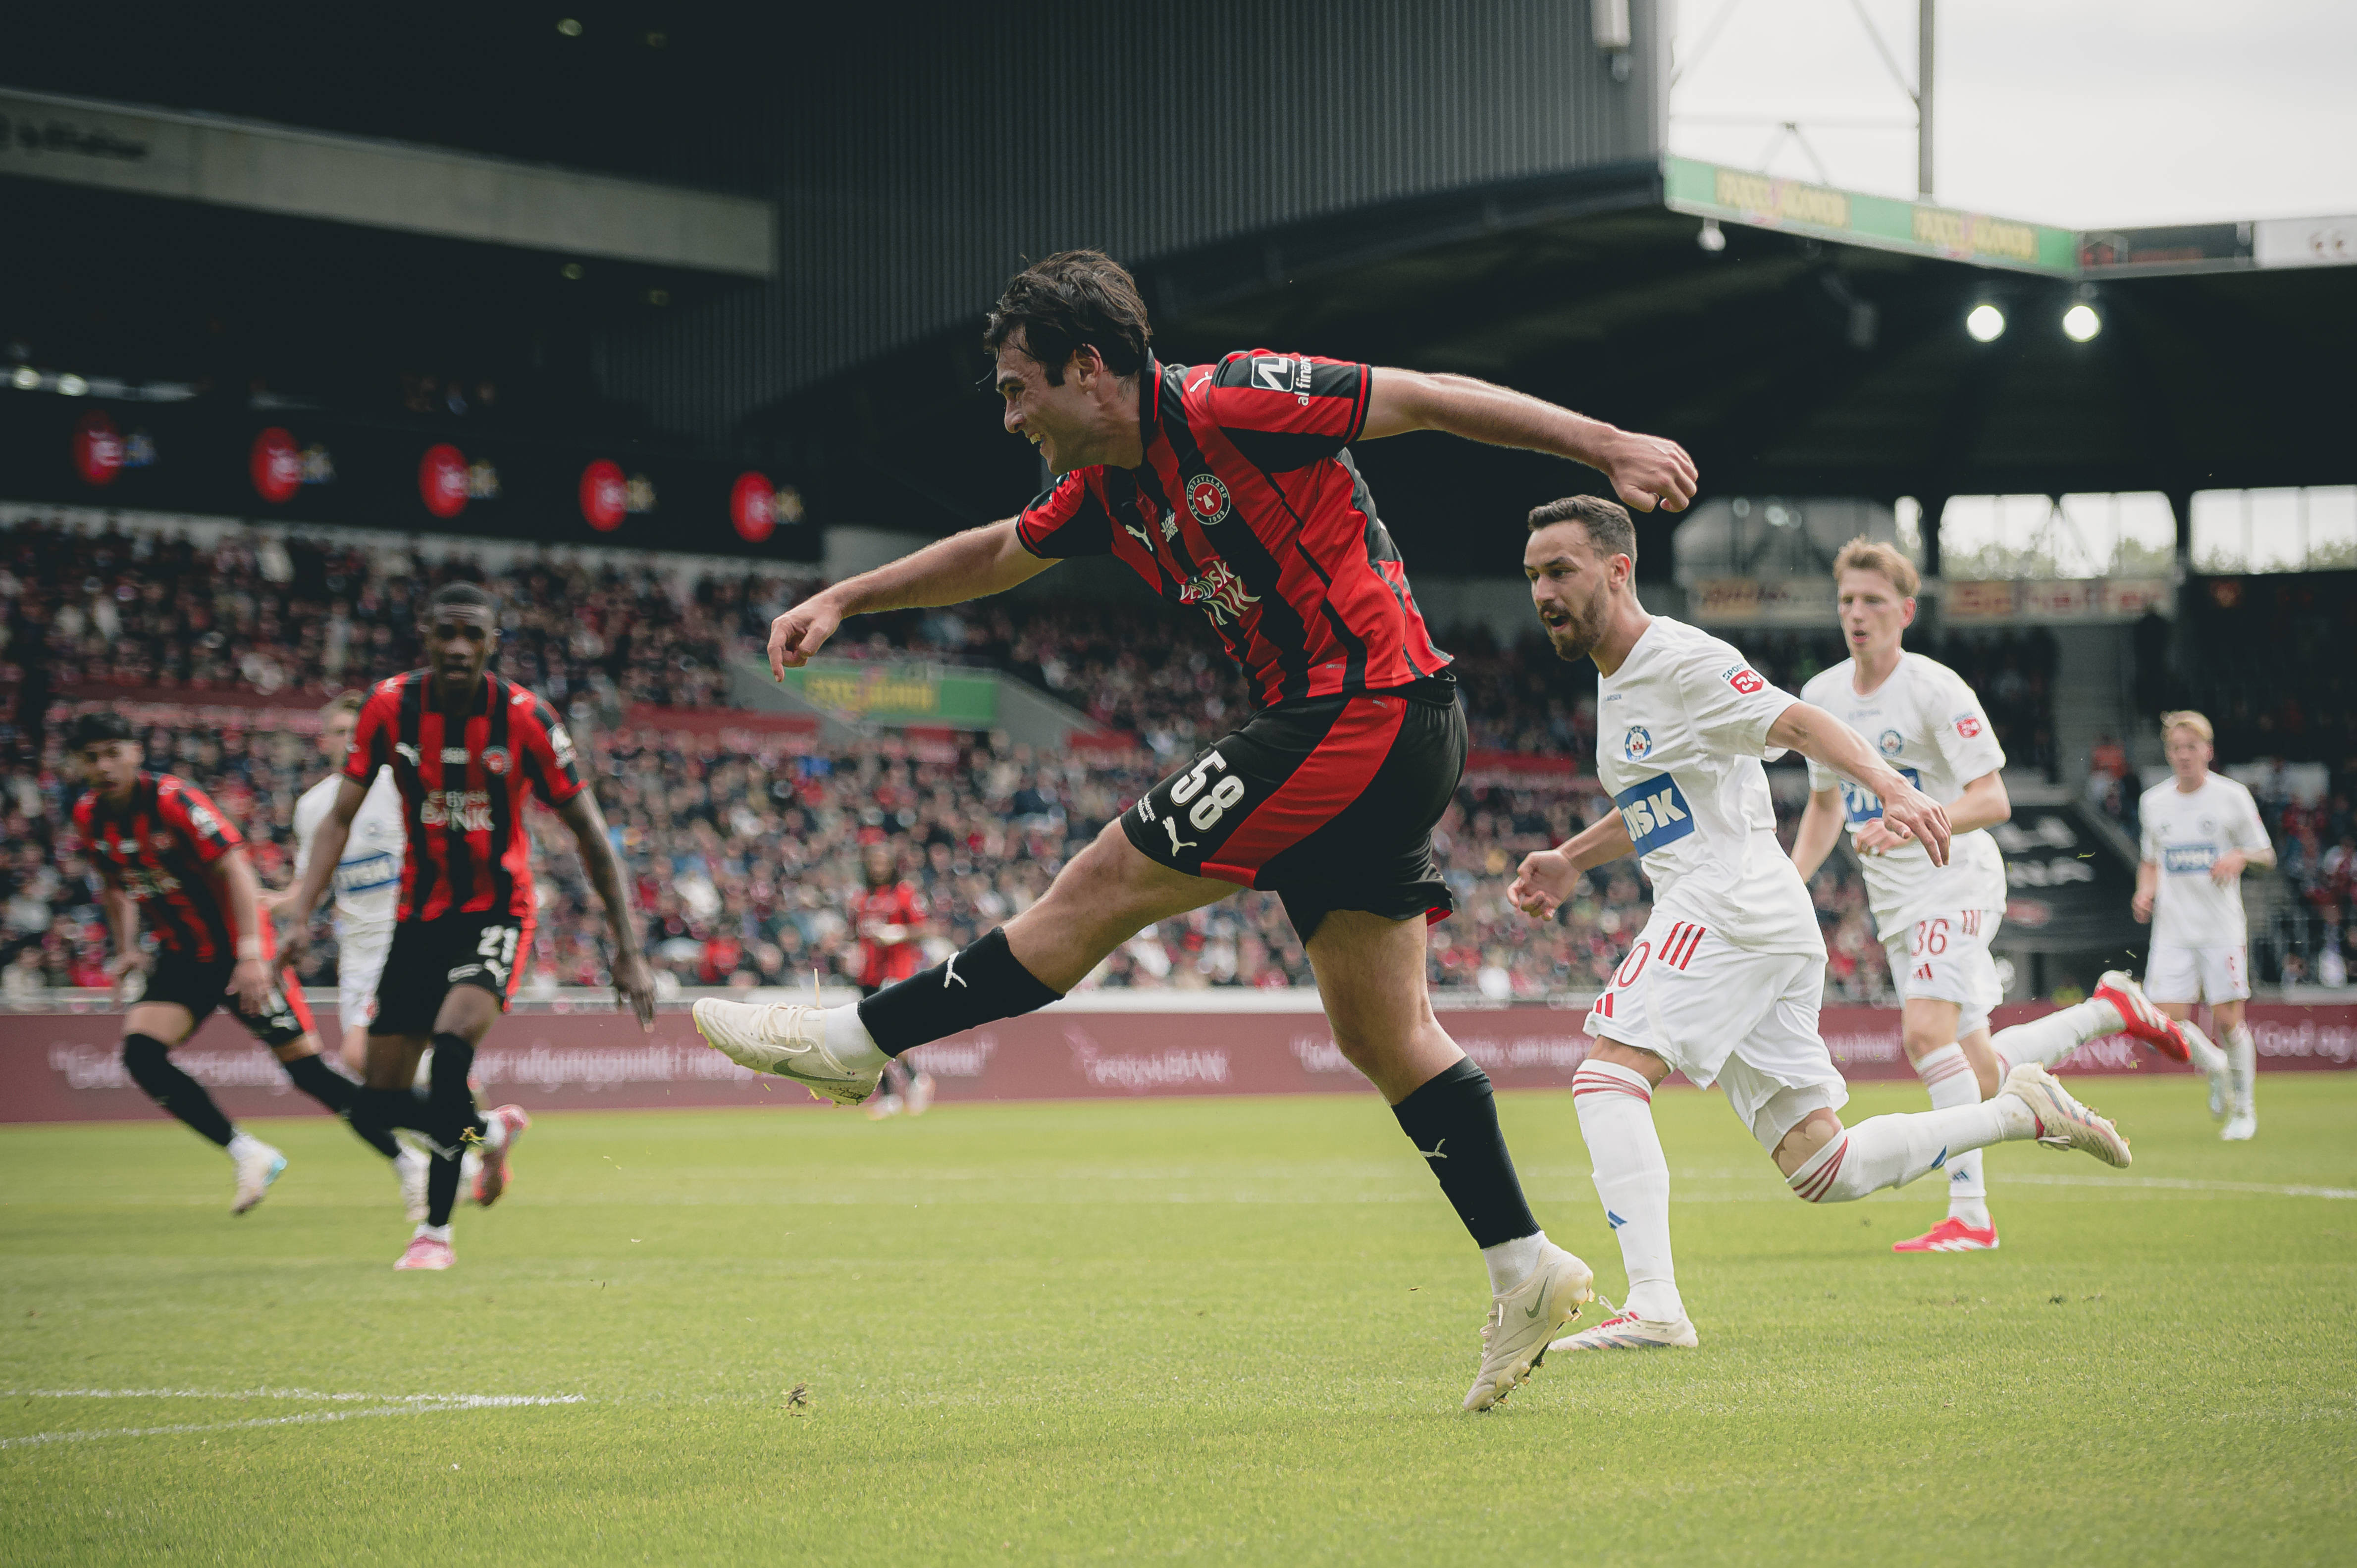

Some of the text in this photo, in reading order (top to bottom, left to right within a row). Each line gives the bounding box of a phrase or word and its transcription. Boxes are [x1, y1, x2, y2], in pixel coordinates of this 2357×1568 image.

[1294, 391, 1309, 406] al
[1188, 476, 1228, 516] FC MIDTJYLLAND
[1208, 511, 1225, 523] 1999
[1735, 672, 1761, 691] 24
[1170, 750, 1245, 833] 58
[477, 925, 519, 964] 21
[1911, 918, 1949, 957] 36
